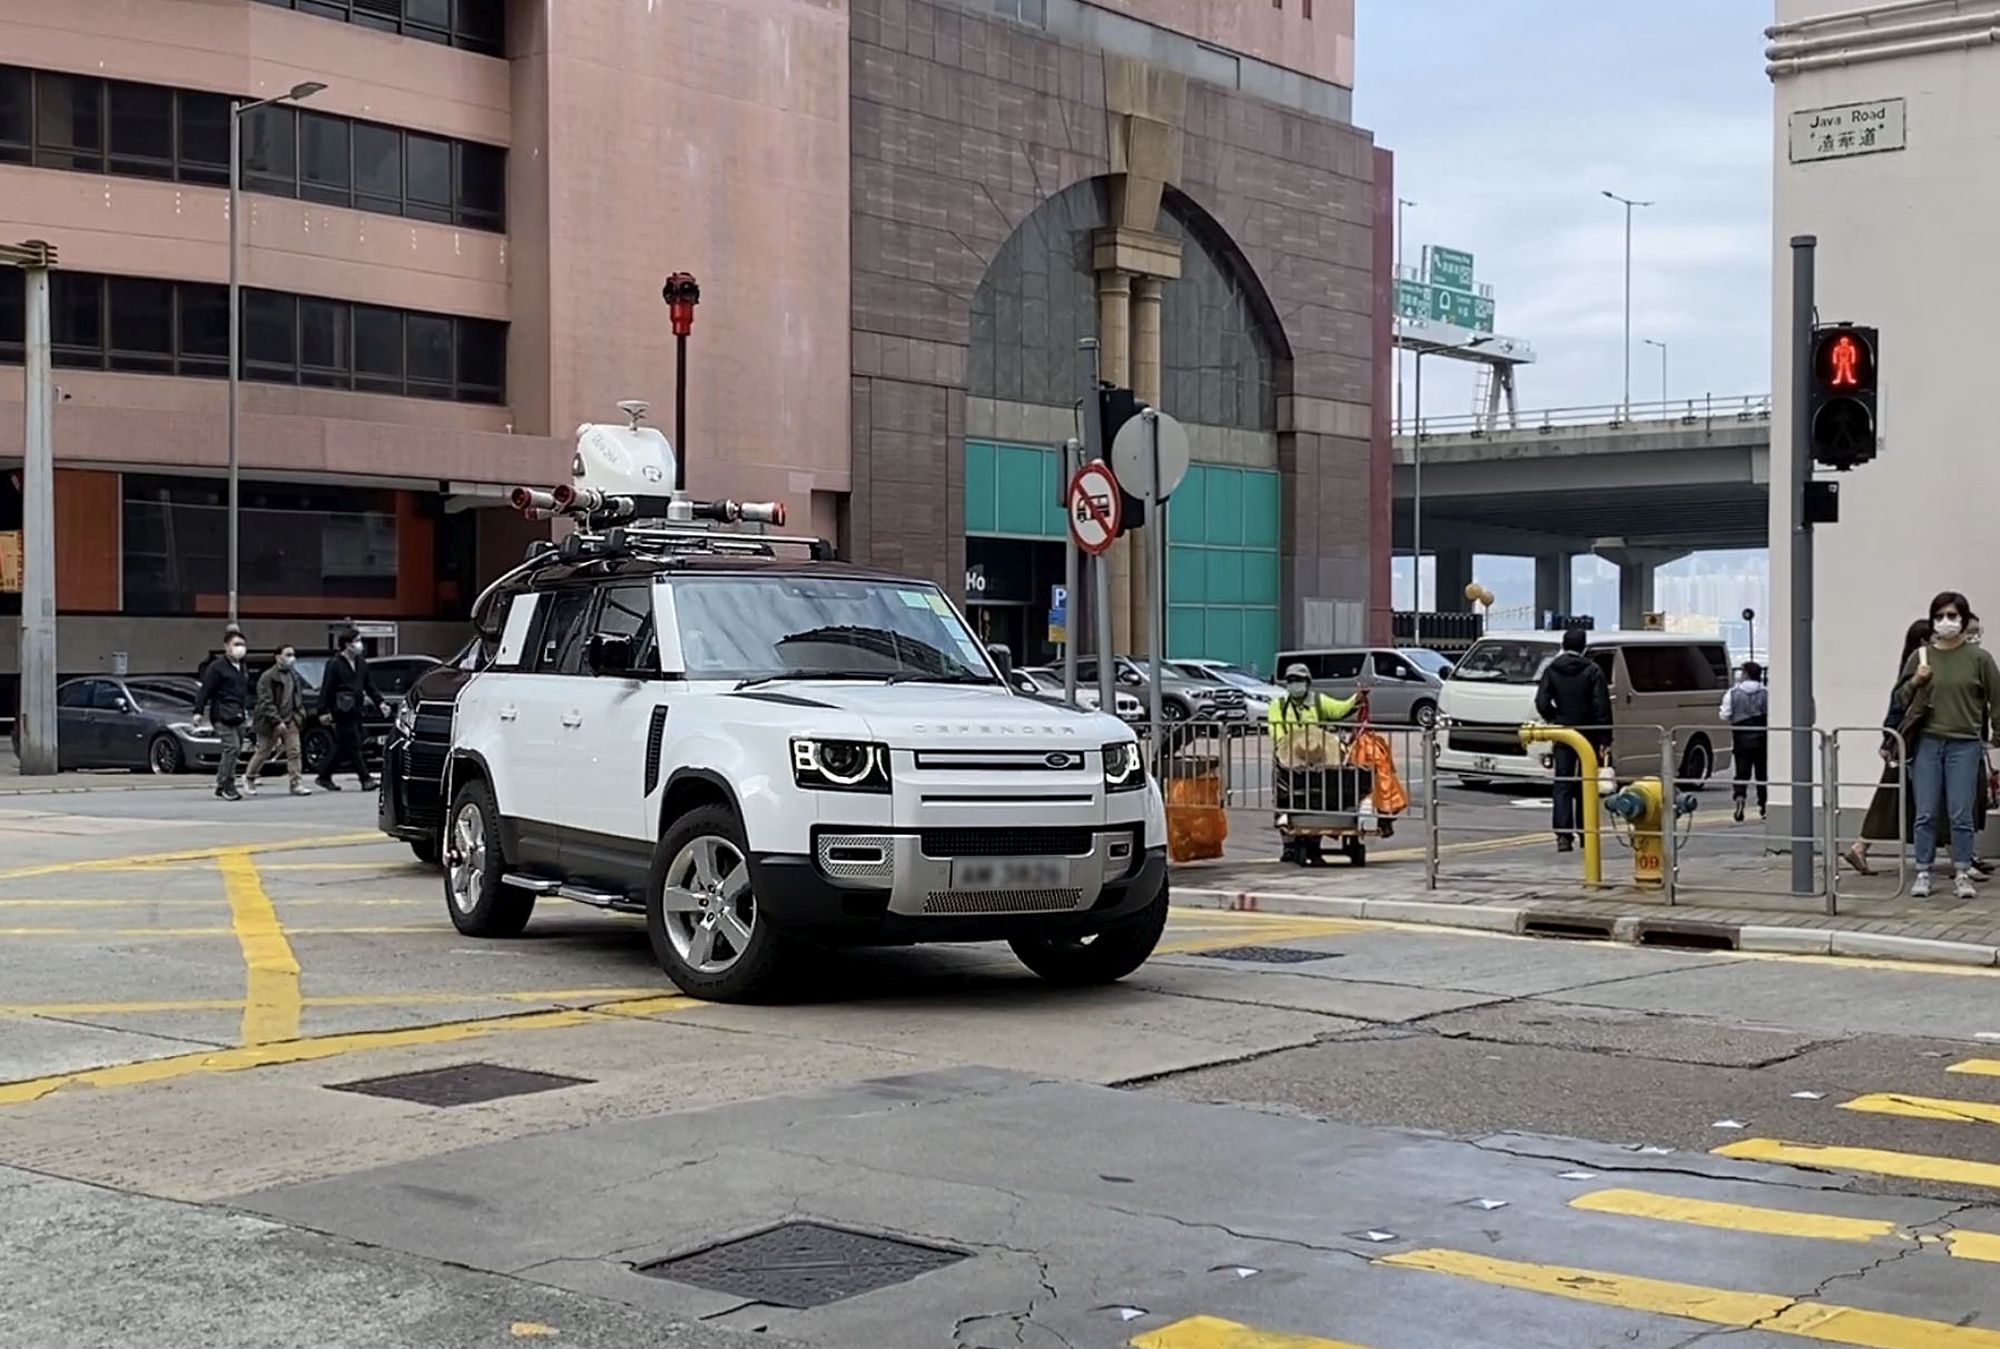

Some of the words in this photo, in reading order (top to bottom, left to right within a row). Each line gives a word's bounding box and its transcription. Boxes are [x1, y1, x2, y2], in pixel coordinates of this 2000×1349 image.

[1810, 116, 1842, 129] Java
[1851, 107, 1886, 123] Road
[1055, 588, 1067, 607] P
[913, 724, 1075, 735] DEFENDER
